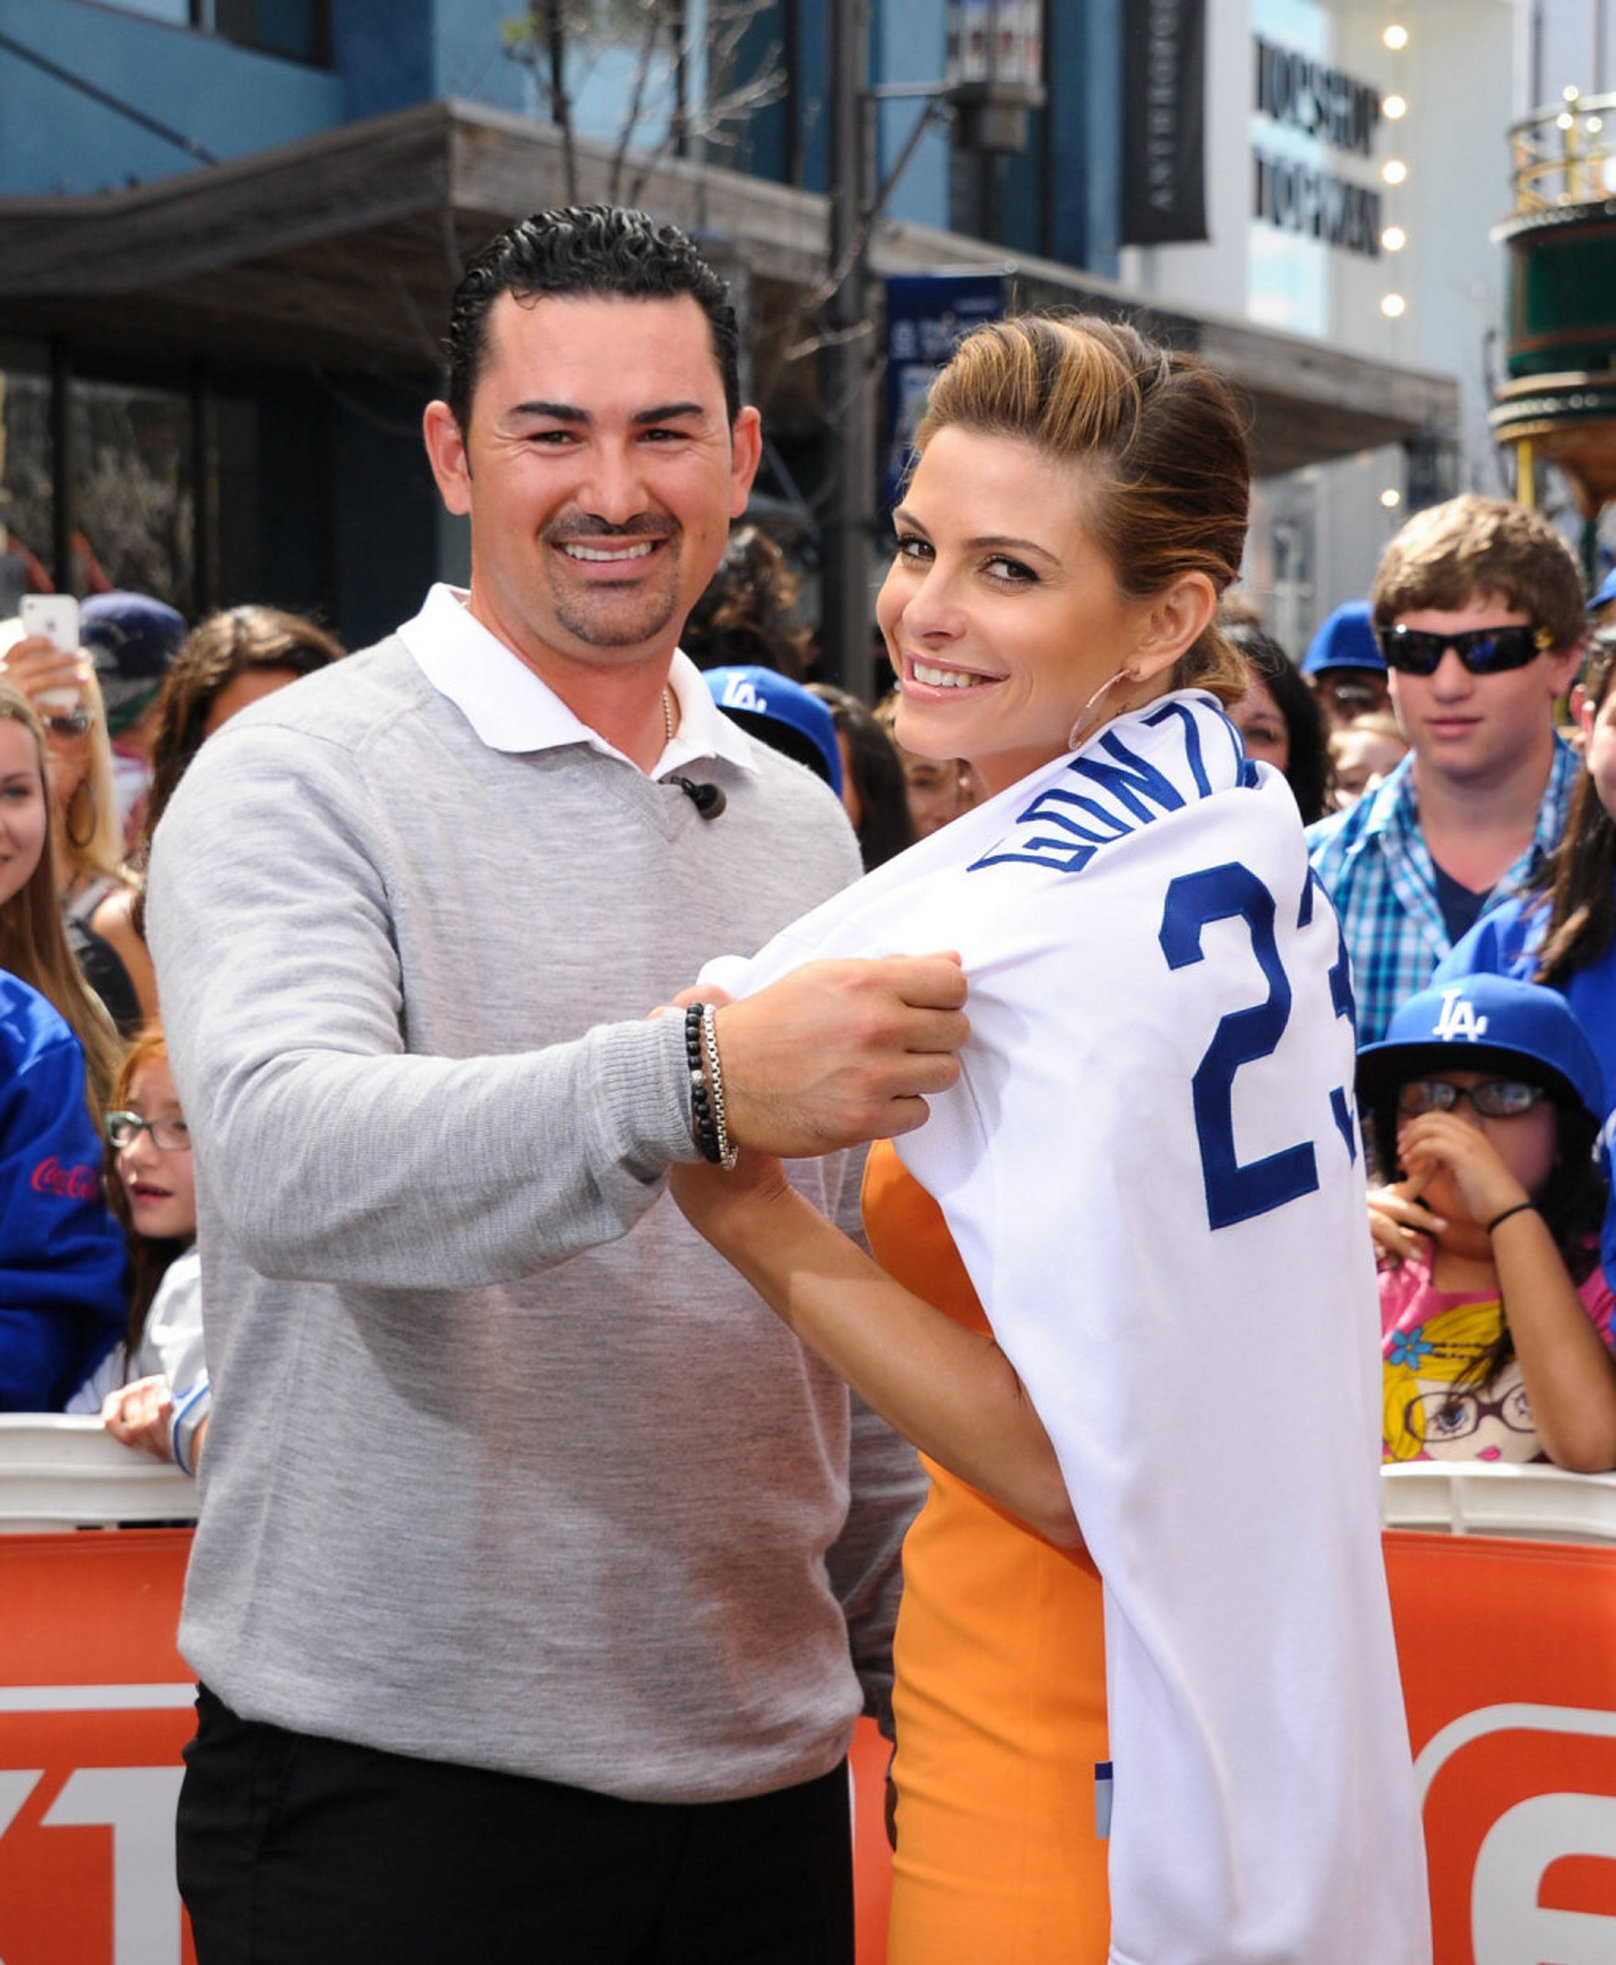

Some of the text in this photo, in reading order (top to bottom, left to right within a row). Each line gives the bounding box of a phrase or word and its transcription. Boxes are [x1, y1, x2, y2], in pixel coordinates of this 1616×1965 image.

[1147, 0, 1178, 211] ANTHROPO
[721, 672, 767, 713] LA
[966, 697, 1258, 872] GONZ
[1432, 988, 1488, 1042] LA
